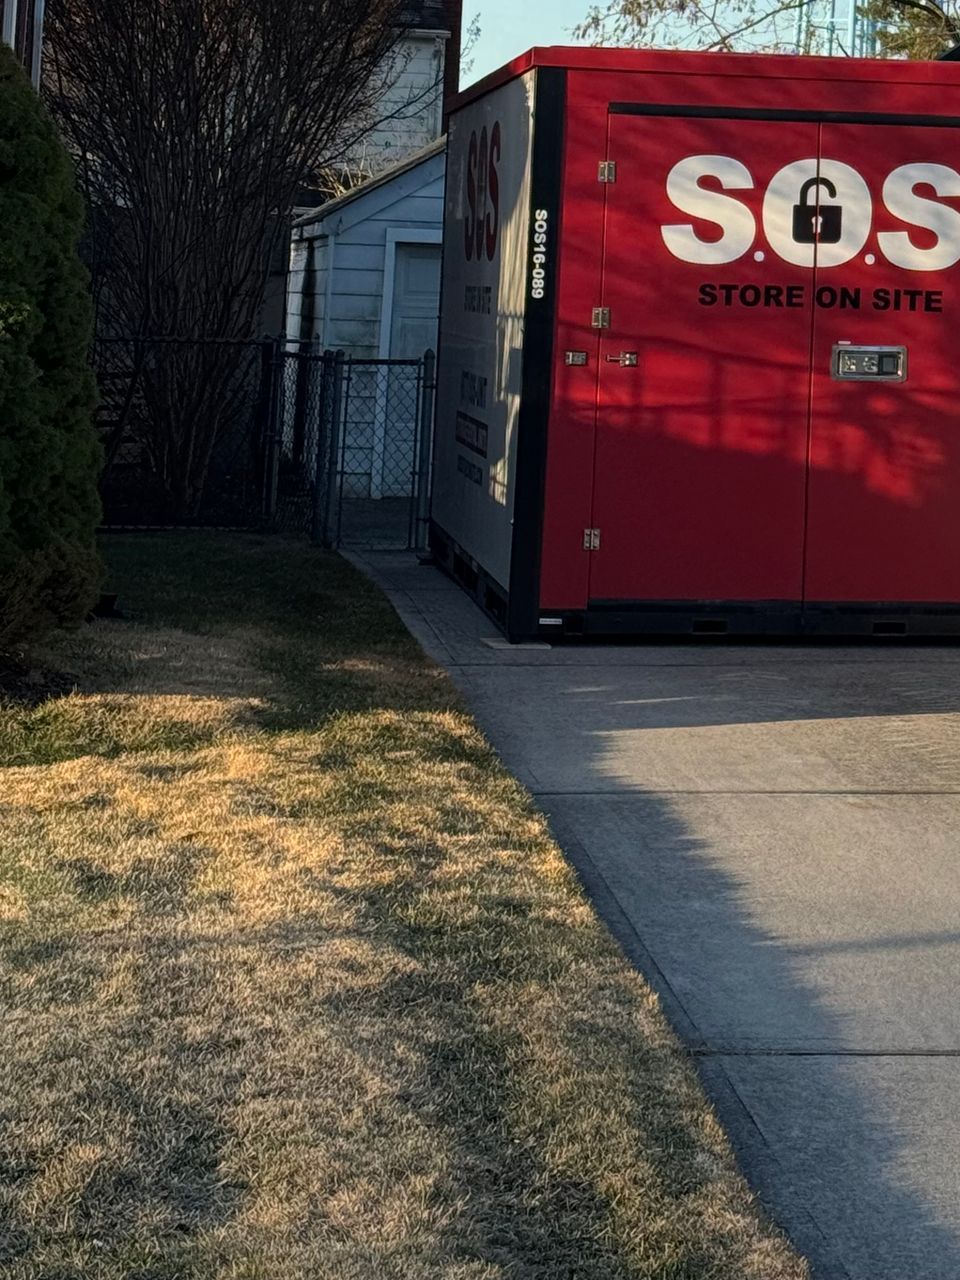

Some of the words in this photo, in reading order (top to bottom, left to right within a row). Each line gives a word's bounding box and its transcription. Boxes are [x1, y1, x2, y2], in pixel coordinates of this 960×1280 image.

[531, 209, 548, 299] SOS16-089
[699, 283, 804, 308] STORE
[815, 286, 861, 310] ON
[872, 288, 943, 313] SITE
